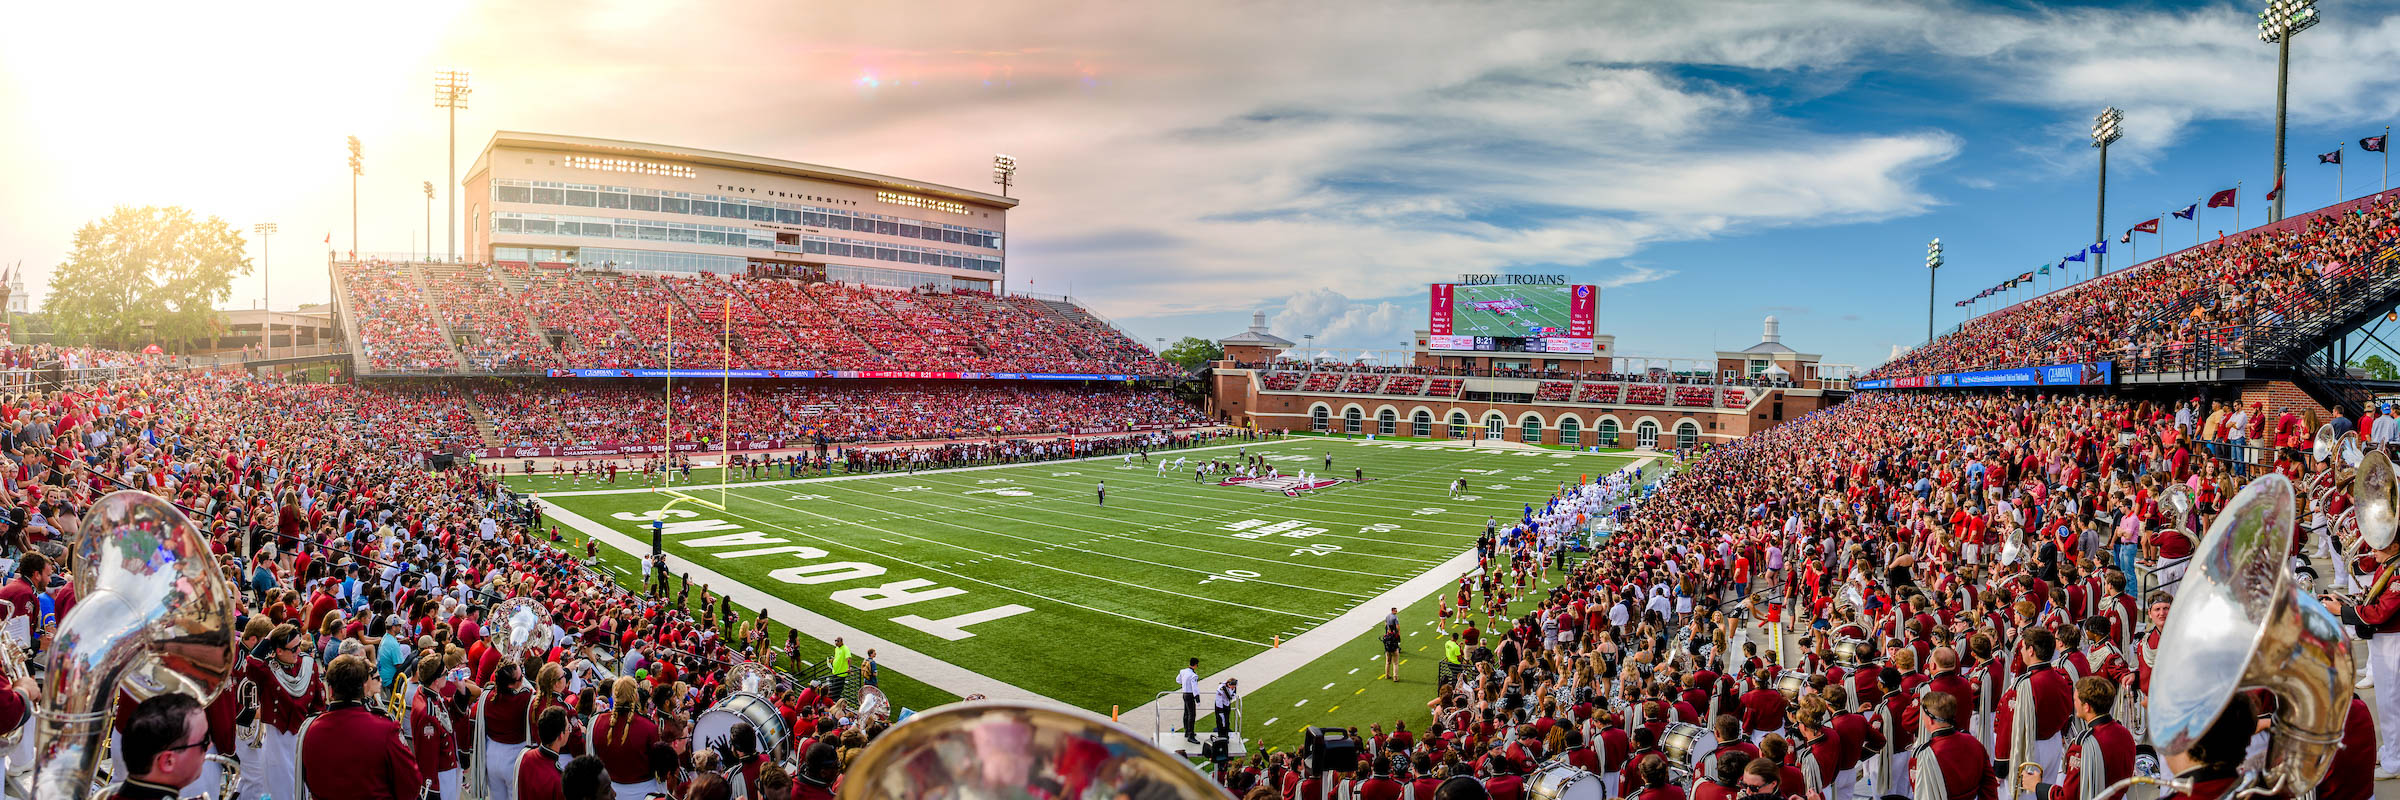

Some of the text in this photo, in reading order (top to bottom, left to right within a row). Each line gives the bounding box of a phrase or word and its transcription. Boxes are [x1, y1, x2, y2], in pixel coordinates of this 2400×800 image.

[717, 184, 857, 206] TROY UNIVERSITY
[1463, 274, 1565, 286] TROY TROJANS
[1440, 298, 1446, 308] 7
[1580, 299, 1586, 310] 7
[1476, 336, 1493, 345] 8:21
[2048, 367, 2073, 382] GUARDIAN
[748, 440, 770, 450] Coca-Cola
[515, 447, 541, 457] Coca-Cola
[1293, 543, 1343, 556] 20
[611, 508, 1035, 641] TROJANS
[1207, 569, 1262, 583] 10
